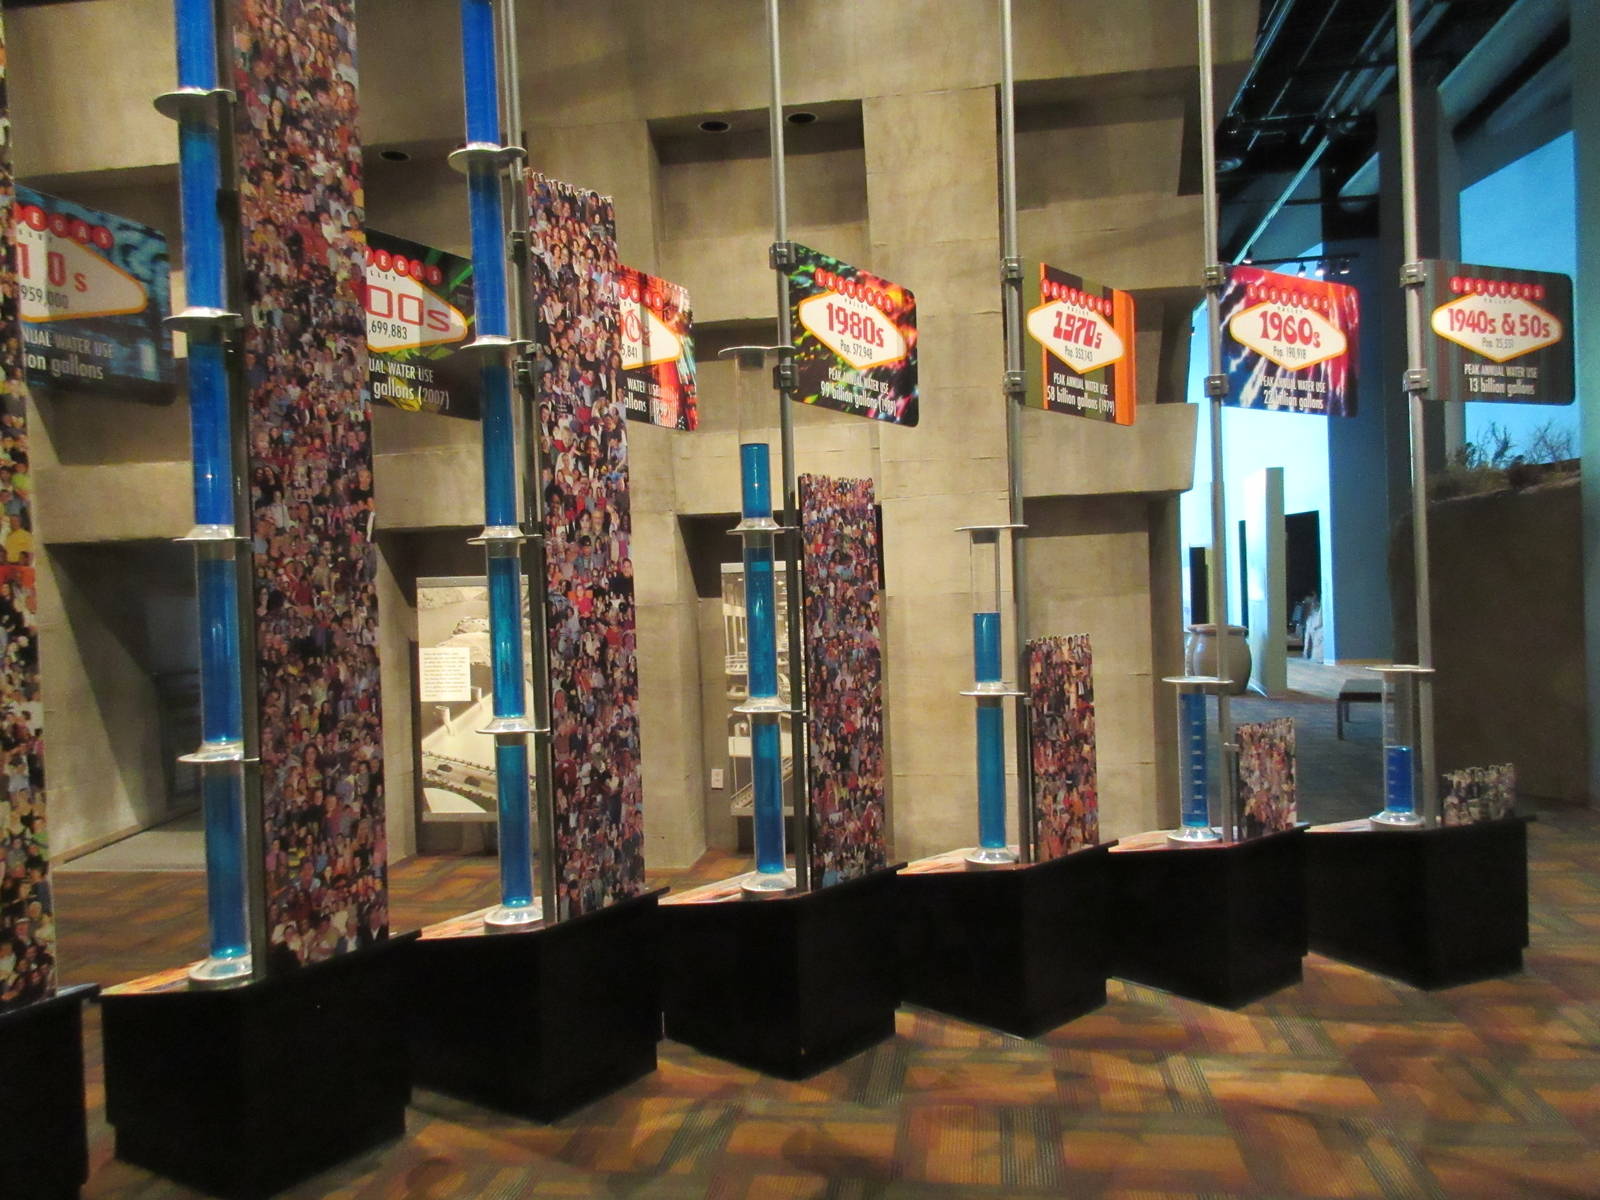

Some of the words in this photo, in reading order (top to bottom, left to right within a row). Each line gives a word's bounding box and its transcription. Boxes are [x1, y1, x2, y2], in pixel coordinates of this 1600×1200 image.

[826, 303, 884, 347] 1980s
[1053, 311, 1102, 349] 1970s
[1259, 311, 1321, 348] 1960s
[1448, 308, 1496, 334] 1940s
[1502, 313, 1516, 335] &
[1520, 315, 1551, 338] 50s
[51, 353, 103, 379] gallons
[388, 362, 415, 379] WATER
[419, 368, 433, 382] USE
[374, 377, 414, 399] gallons
[419, 386, 449, 410] (2007)
[627, 378, 645, 393] WATER
[832, 385, 853, 402] billion
[854, 390, 878, 408] gallons
[1470, 378, 1478, 392] 13
[1481, 377, 1505, 393] billion
[1507, 379, 1535, 397] gallons
[624, 392, 647, 412] allons
[1057, 386, 1075, 405] billion
[1077, 392, 1097, 410] gallons
[1299, 392, 1324, 410] gallons
